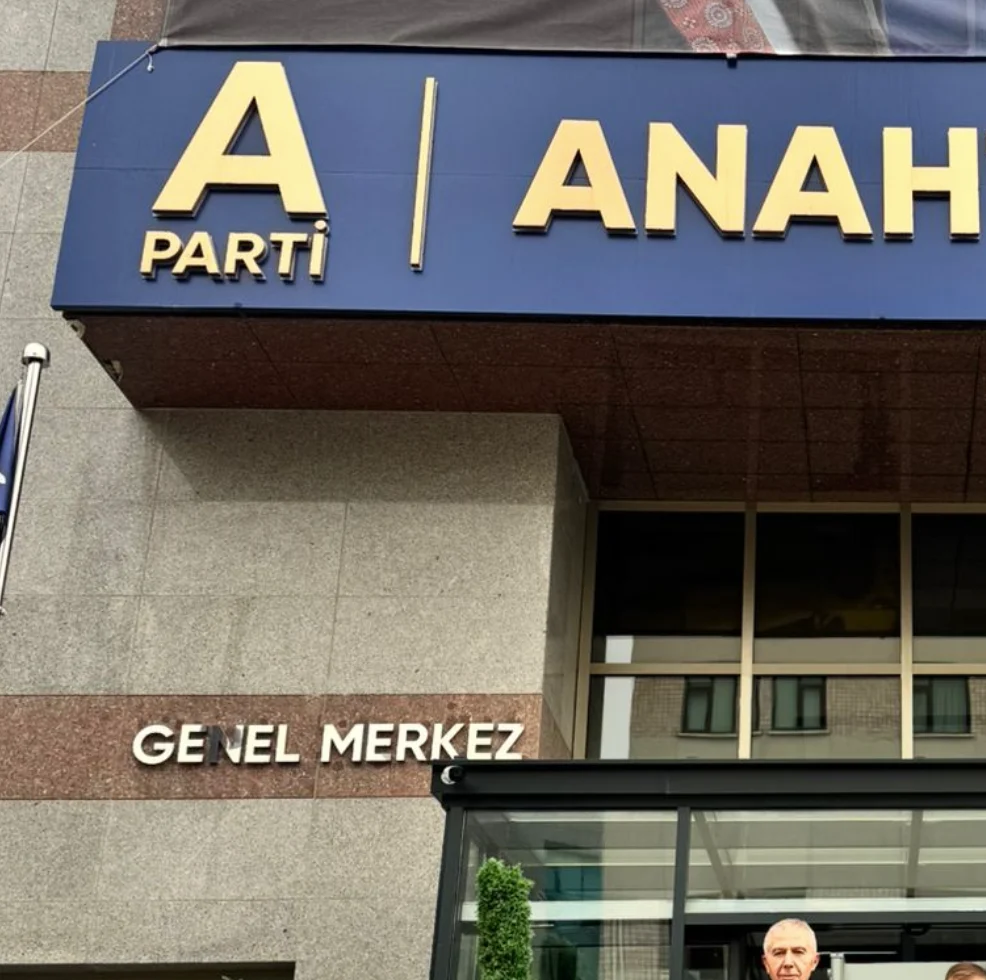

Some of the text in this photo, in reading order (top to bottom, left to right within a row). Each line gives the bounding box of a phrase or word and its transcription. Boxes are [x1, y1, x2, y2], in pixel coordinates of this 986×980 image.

[152, 61, 328, 217] A
[140, 219, 329, 281] PARTİ
[132, 723, 523, 765] GENEL MERKEZ
